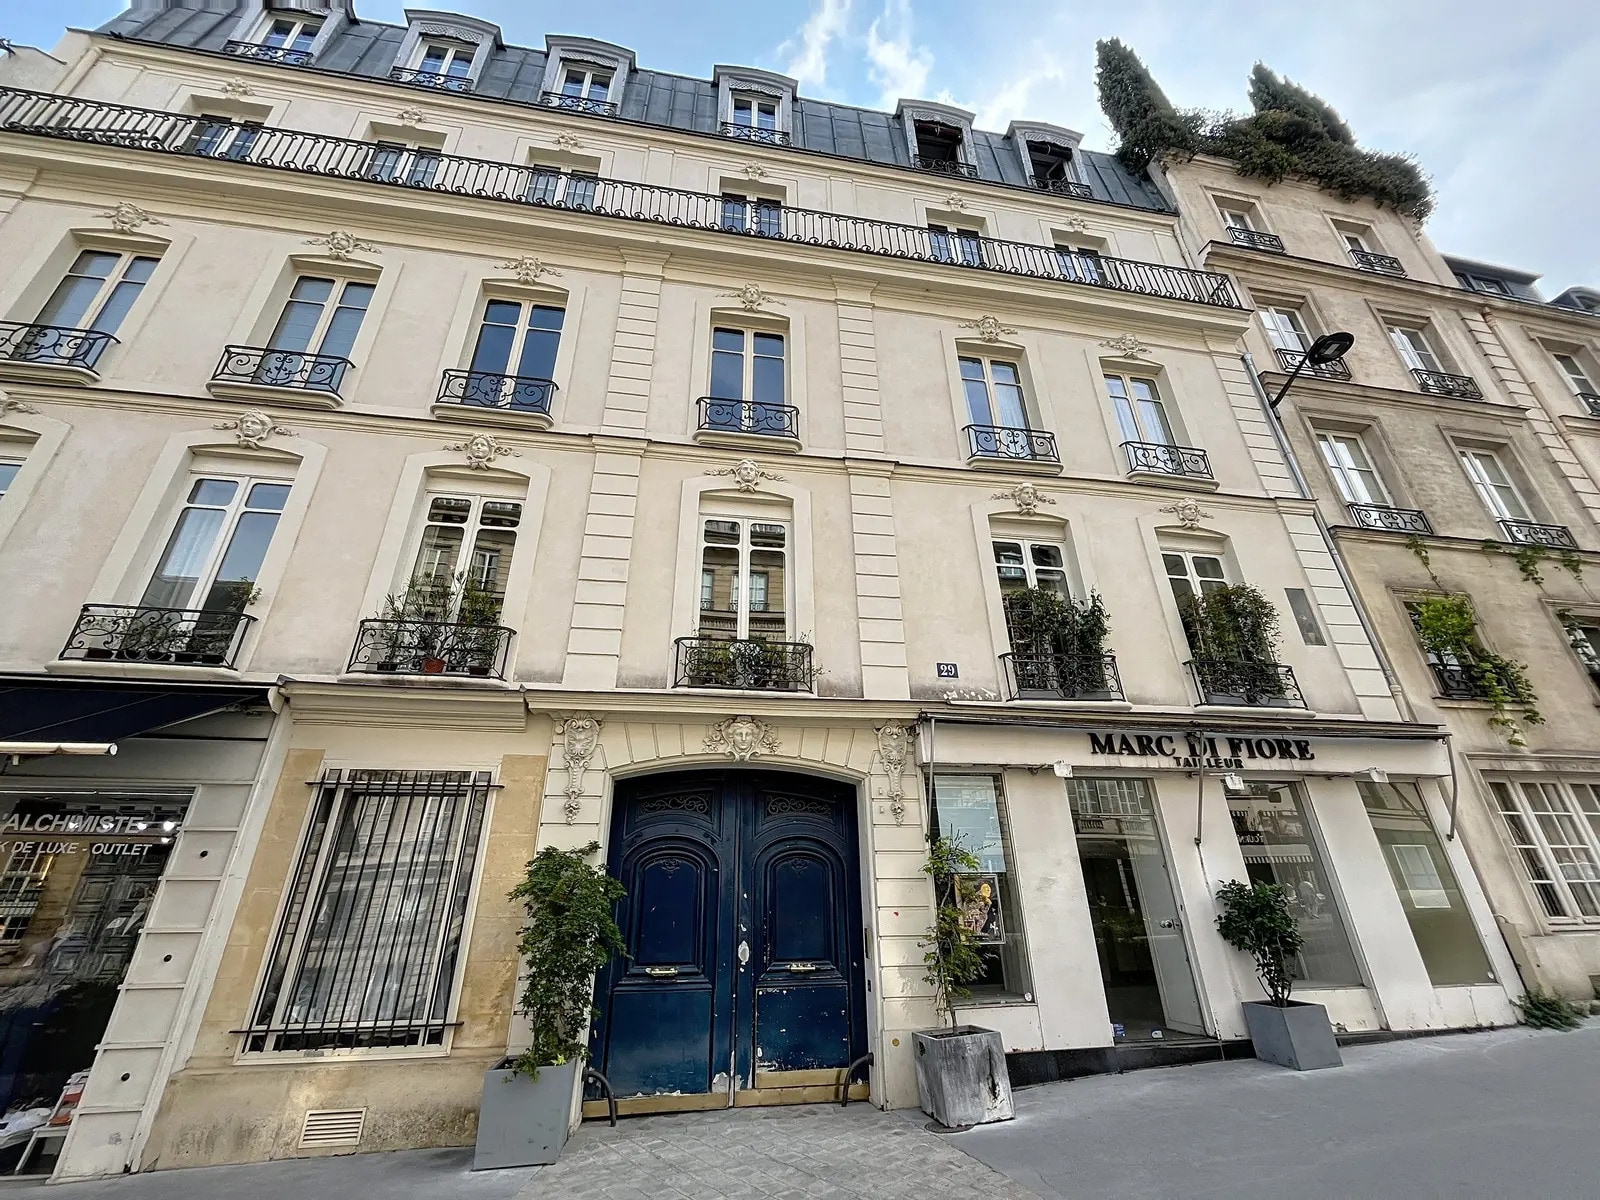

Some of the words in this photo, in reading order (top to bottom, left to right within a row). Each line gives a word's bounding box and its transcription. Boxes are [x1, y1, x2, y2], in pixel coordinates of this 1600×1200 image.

[940, 665, 955, 676] 29
[1087, 732, 1176, 757] MARC
[1184, 734, 1220, 758] DI
[1225, 737, 1315, 760] FIORE
[1173, 756, 1244, 769] TAILLEUR
[11, 842, 35, 853] DE
[36, 842, 80, 854] LUXE
[91, 843, 153, 856] OUTLET
